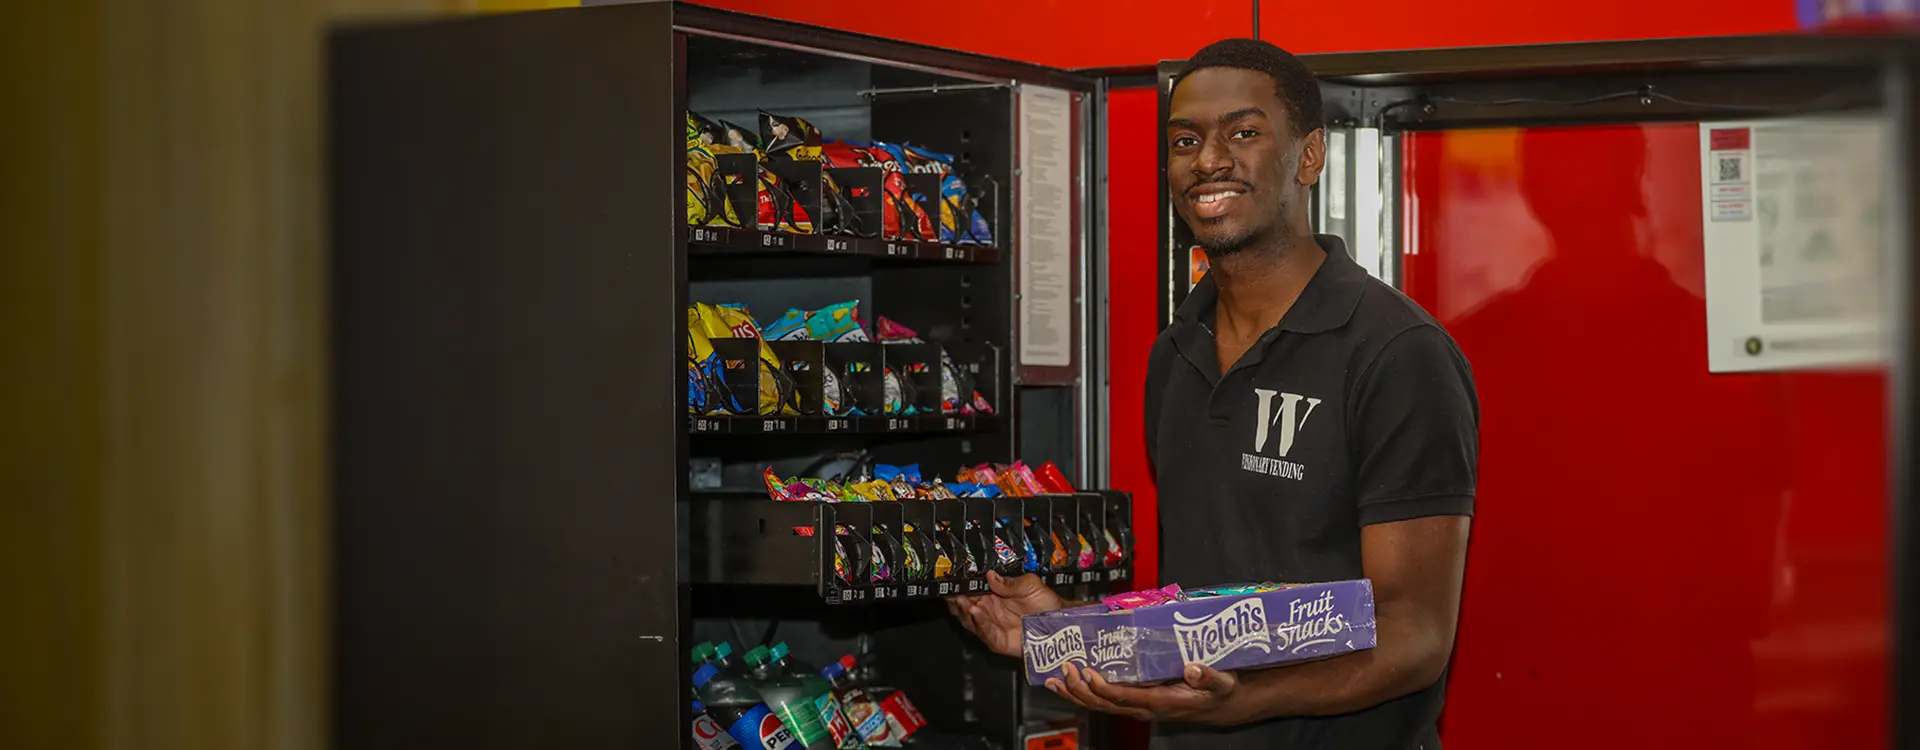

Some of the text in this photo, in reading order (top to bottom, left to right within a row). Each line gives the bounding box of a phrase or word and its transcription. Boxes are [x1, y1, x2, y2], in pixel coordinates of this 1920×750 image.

[1254, 388, 1322, 457] W
[1269, 458, 1305, 480] VENDING
[1288, 589, 1335, 625] Fruit
[1030, 628, 1083, 668] Welch's
[1097, 625, 1126, 649] Fruit
[1178, 602, 1264, 662] Welch's
[1277, 611, 1344, 651] Snacks
[1090, 640, 1135, 667] Snacks
